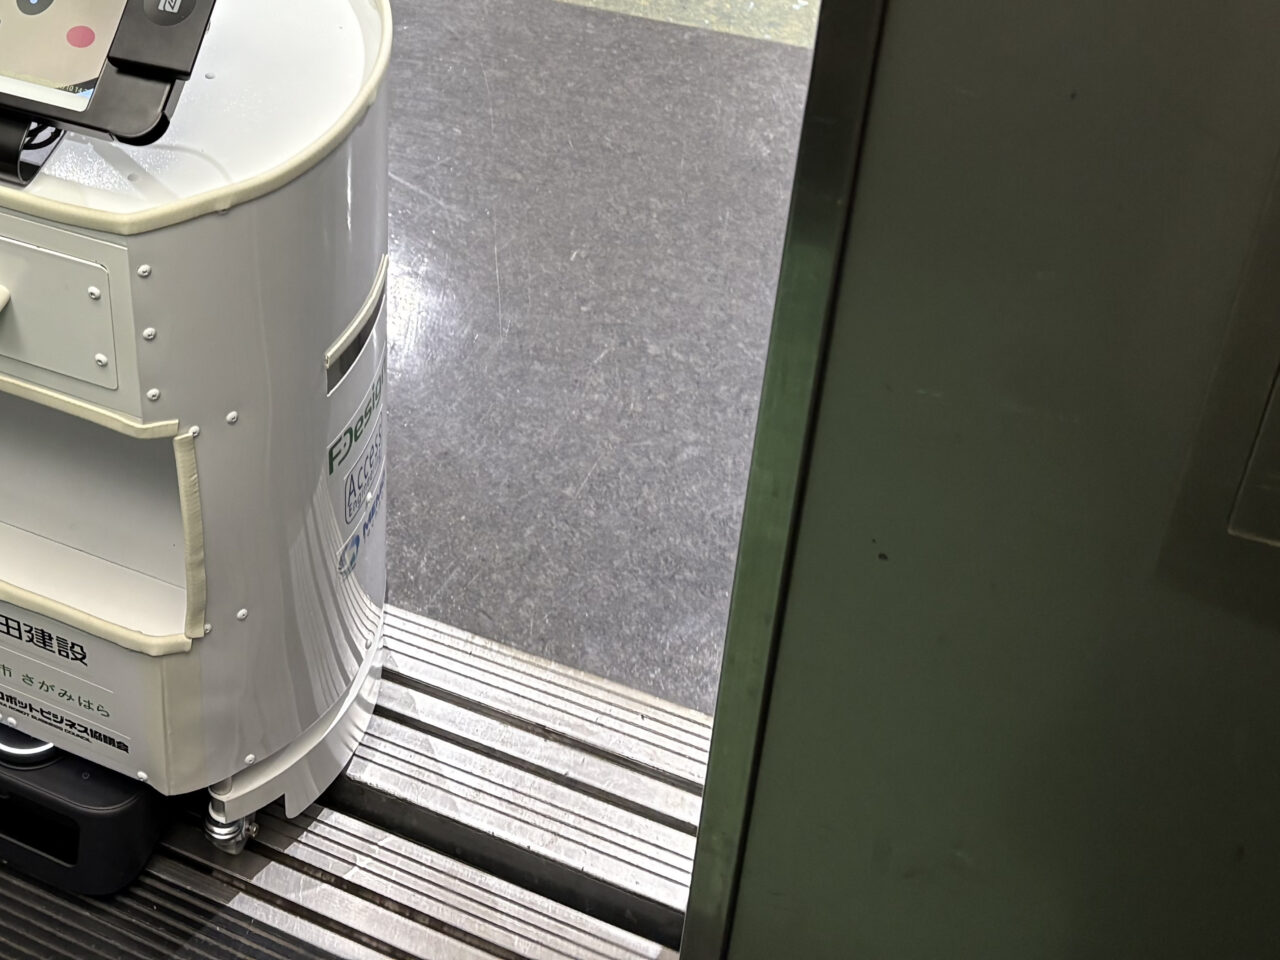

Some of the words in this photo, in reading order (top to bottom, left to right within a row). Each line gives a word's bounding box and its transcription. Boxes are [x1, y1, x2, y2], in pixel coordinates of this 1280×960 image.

[21, 672, 111, 718] さがみはら
